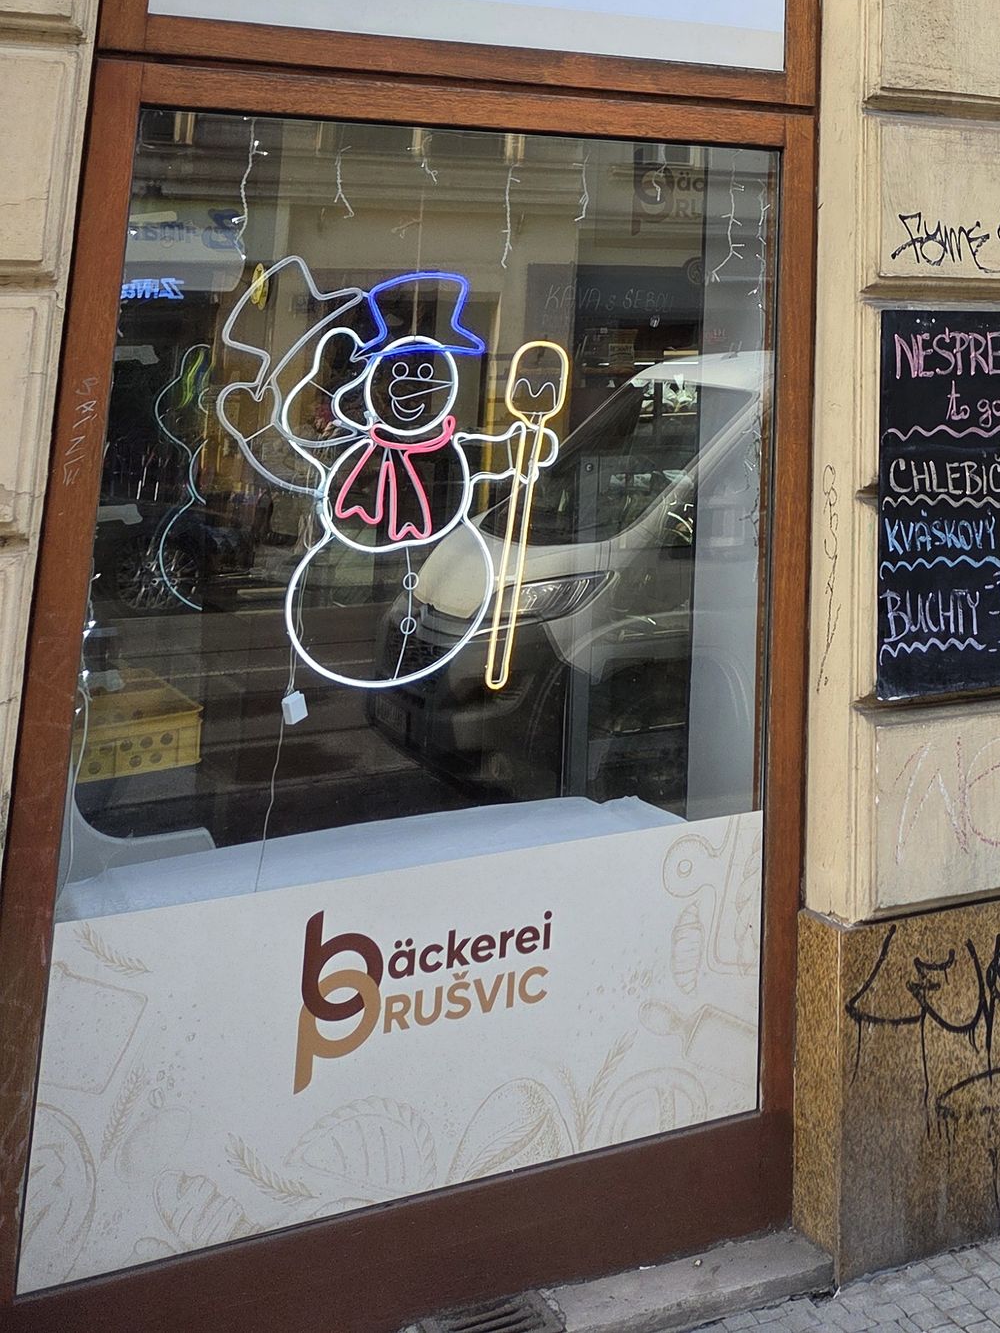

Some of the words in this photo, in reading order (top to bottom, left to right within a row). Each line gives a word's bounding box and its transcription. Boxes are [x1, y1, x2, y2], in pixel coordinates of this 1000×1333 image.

[946, 380, 970, 421] to
[884, 508, 997, 556] KVÁSKOVÝ
[879, 588, 980, 643] BUCHTY
[302, 910, 552, 1022] bäckerei
